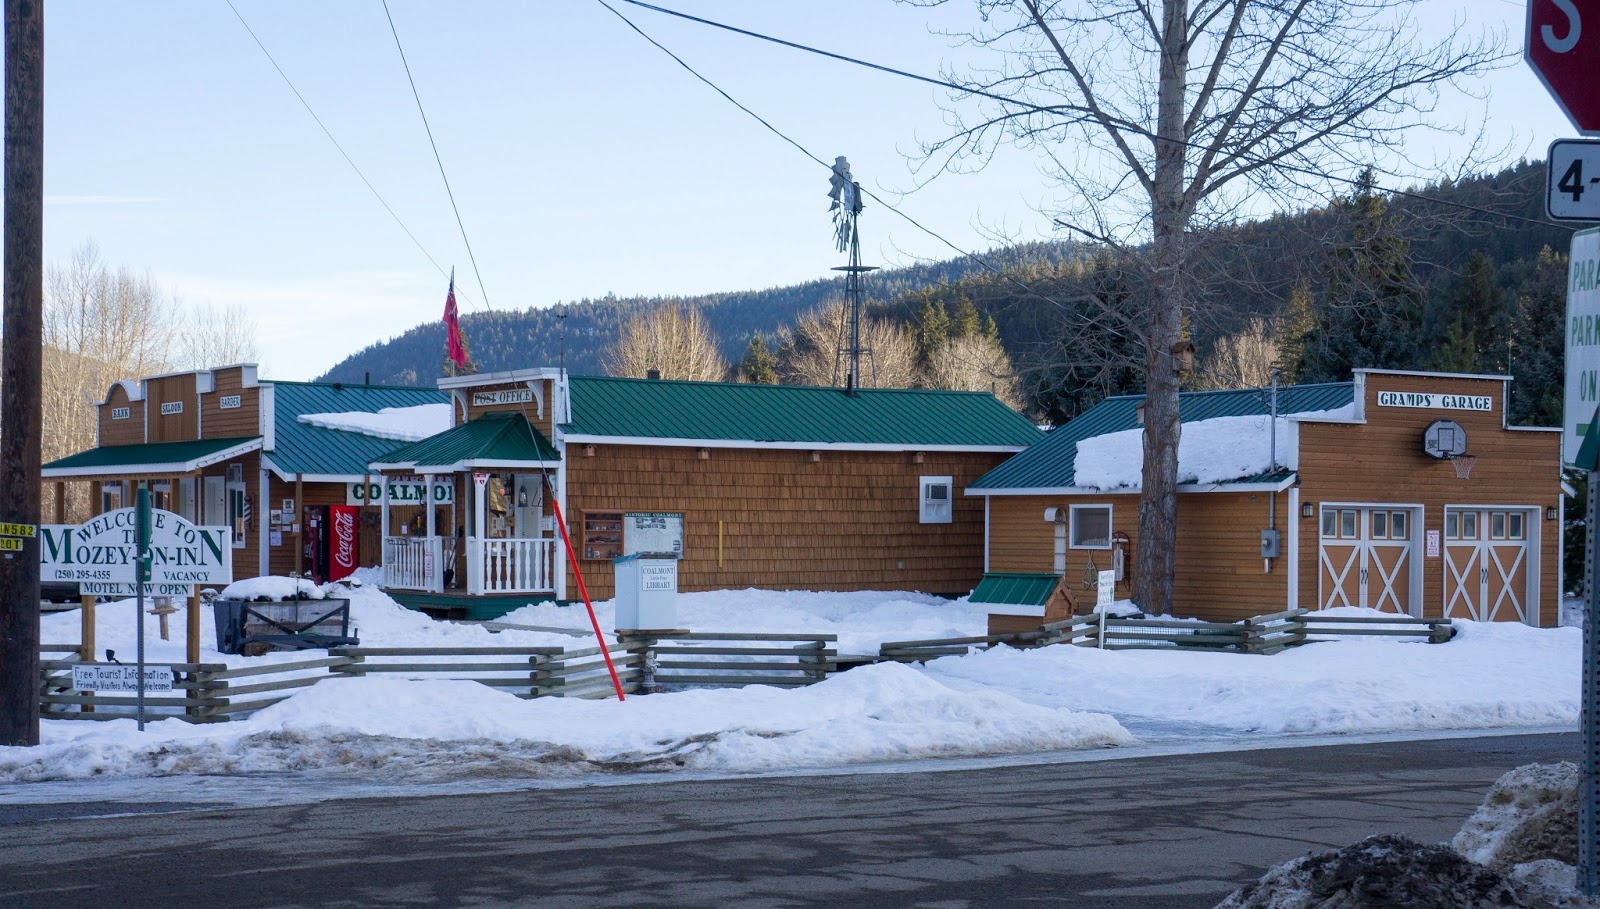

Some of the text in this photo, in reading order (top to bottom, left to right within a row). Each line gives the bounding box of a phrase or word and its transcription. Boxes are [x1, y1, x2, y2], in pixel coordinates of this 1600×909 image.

[499, 389, 531, 402] OFFICE
[1380, 392, 1490, 410] GRAMPS' GARAGE
[113, 408, 129, 418] BANK
[162, 402, 182, 413] SALOON
[174, 520, 196, 544] TO
[55, 570, 111, 580] (250) 295-4355
[163, 571, 210, 582] VACANCY
[642, 567, 674, 575] COALMONT
[84, 583, 189, 595] MOTEL NW OPEN
[75, 667, 93, 679] Free
[94, 667, 121, 679] Tourist
